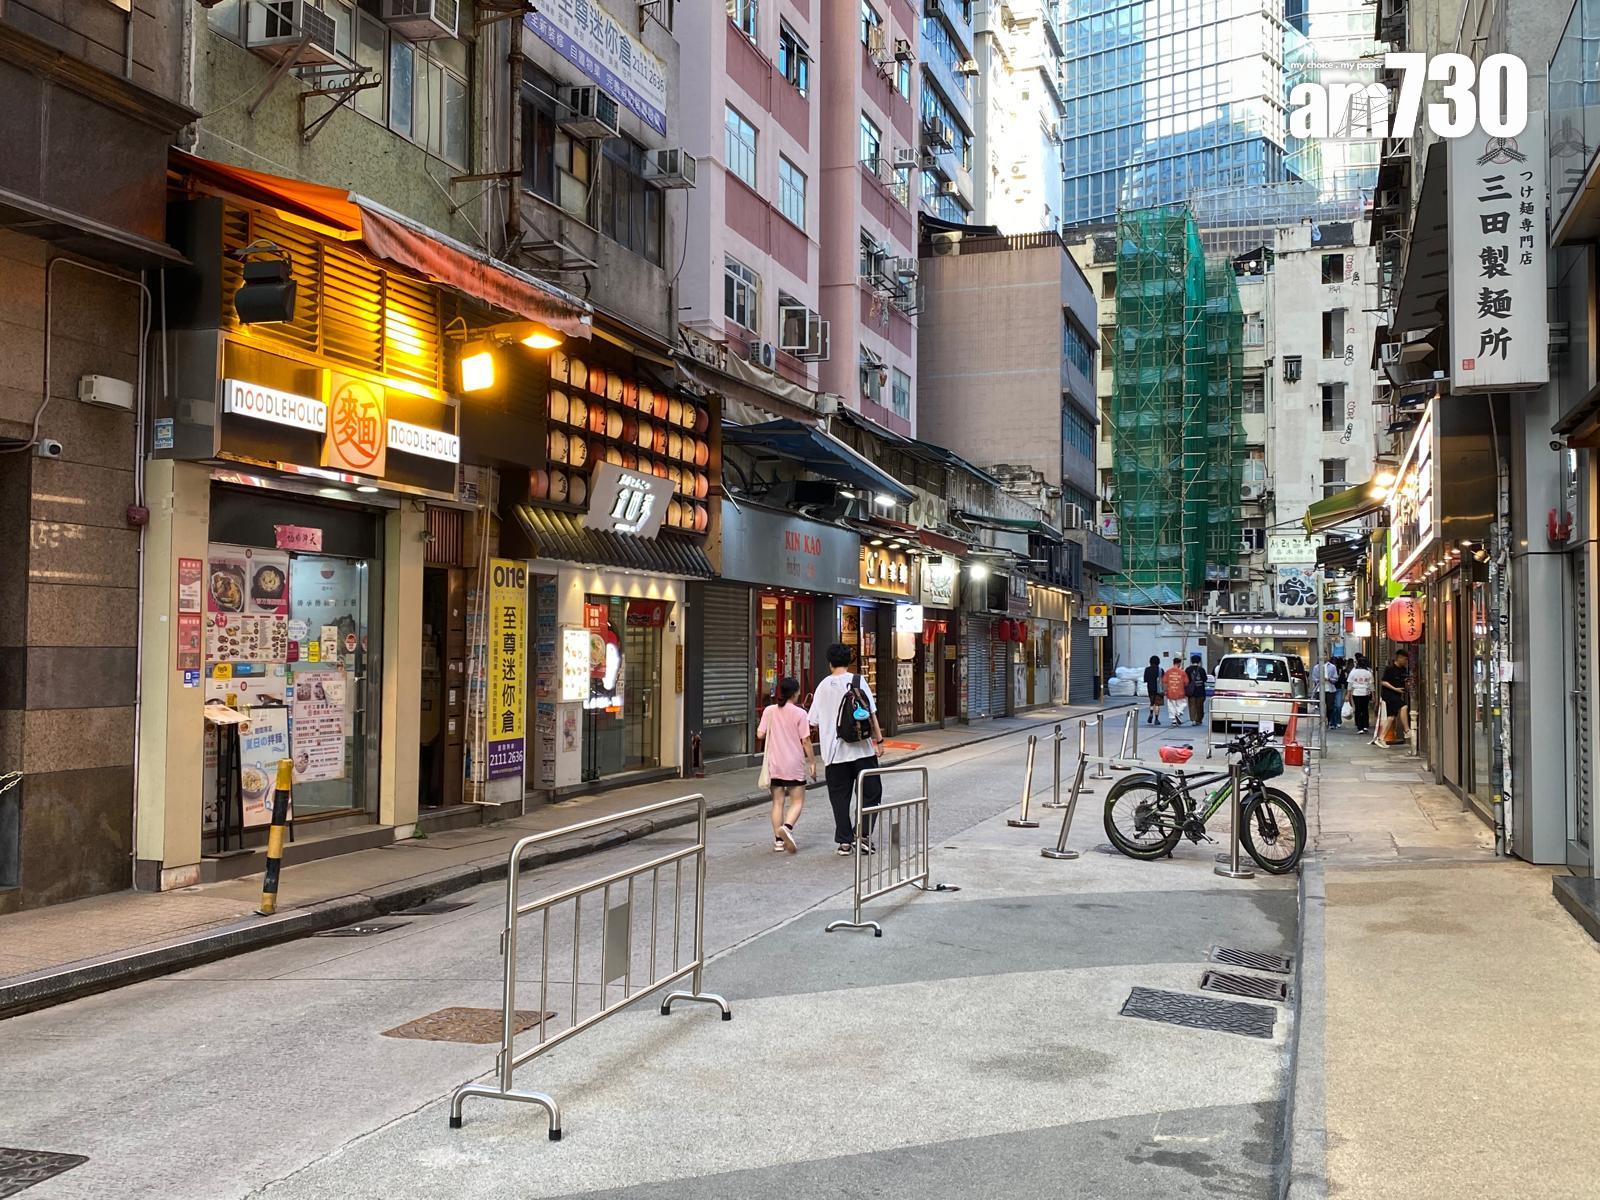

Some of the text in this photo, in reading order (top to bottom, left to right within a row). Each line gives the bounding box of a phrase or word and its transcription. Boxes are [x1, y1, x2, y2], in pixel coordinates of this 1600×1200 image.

[333, 389, 377, 460] 麵
[785, 530, 822, 556] KIN KAO
[493, 565, 525, 589] one
[501, 606, 517, 734] 至尊迷你倉
[489, 750, 524, 766] 2111 2636
